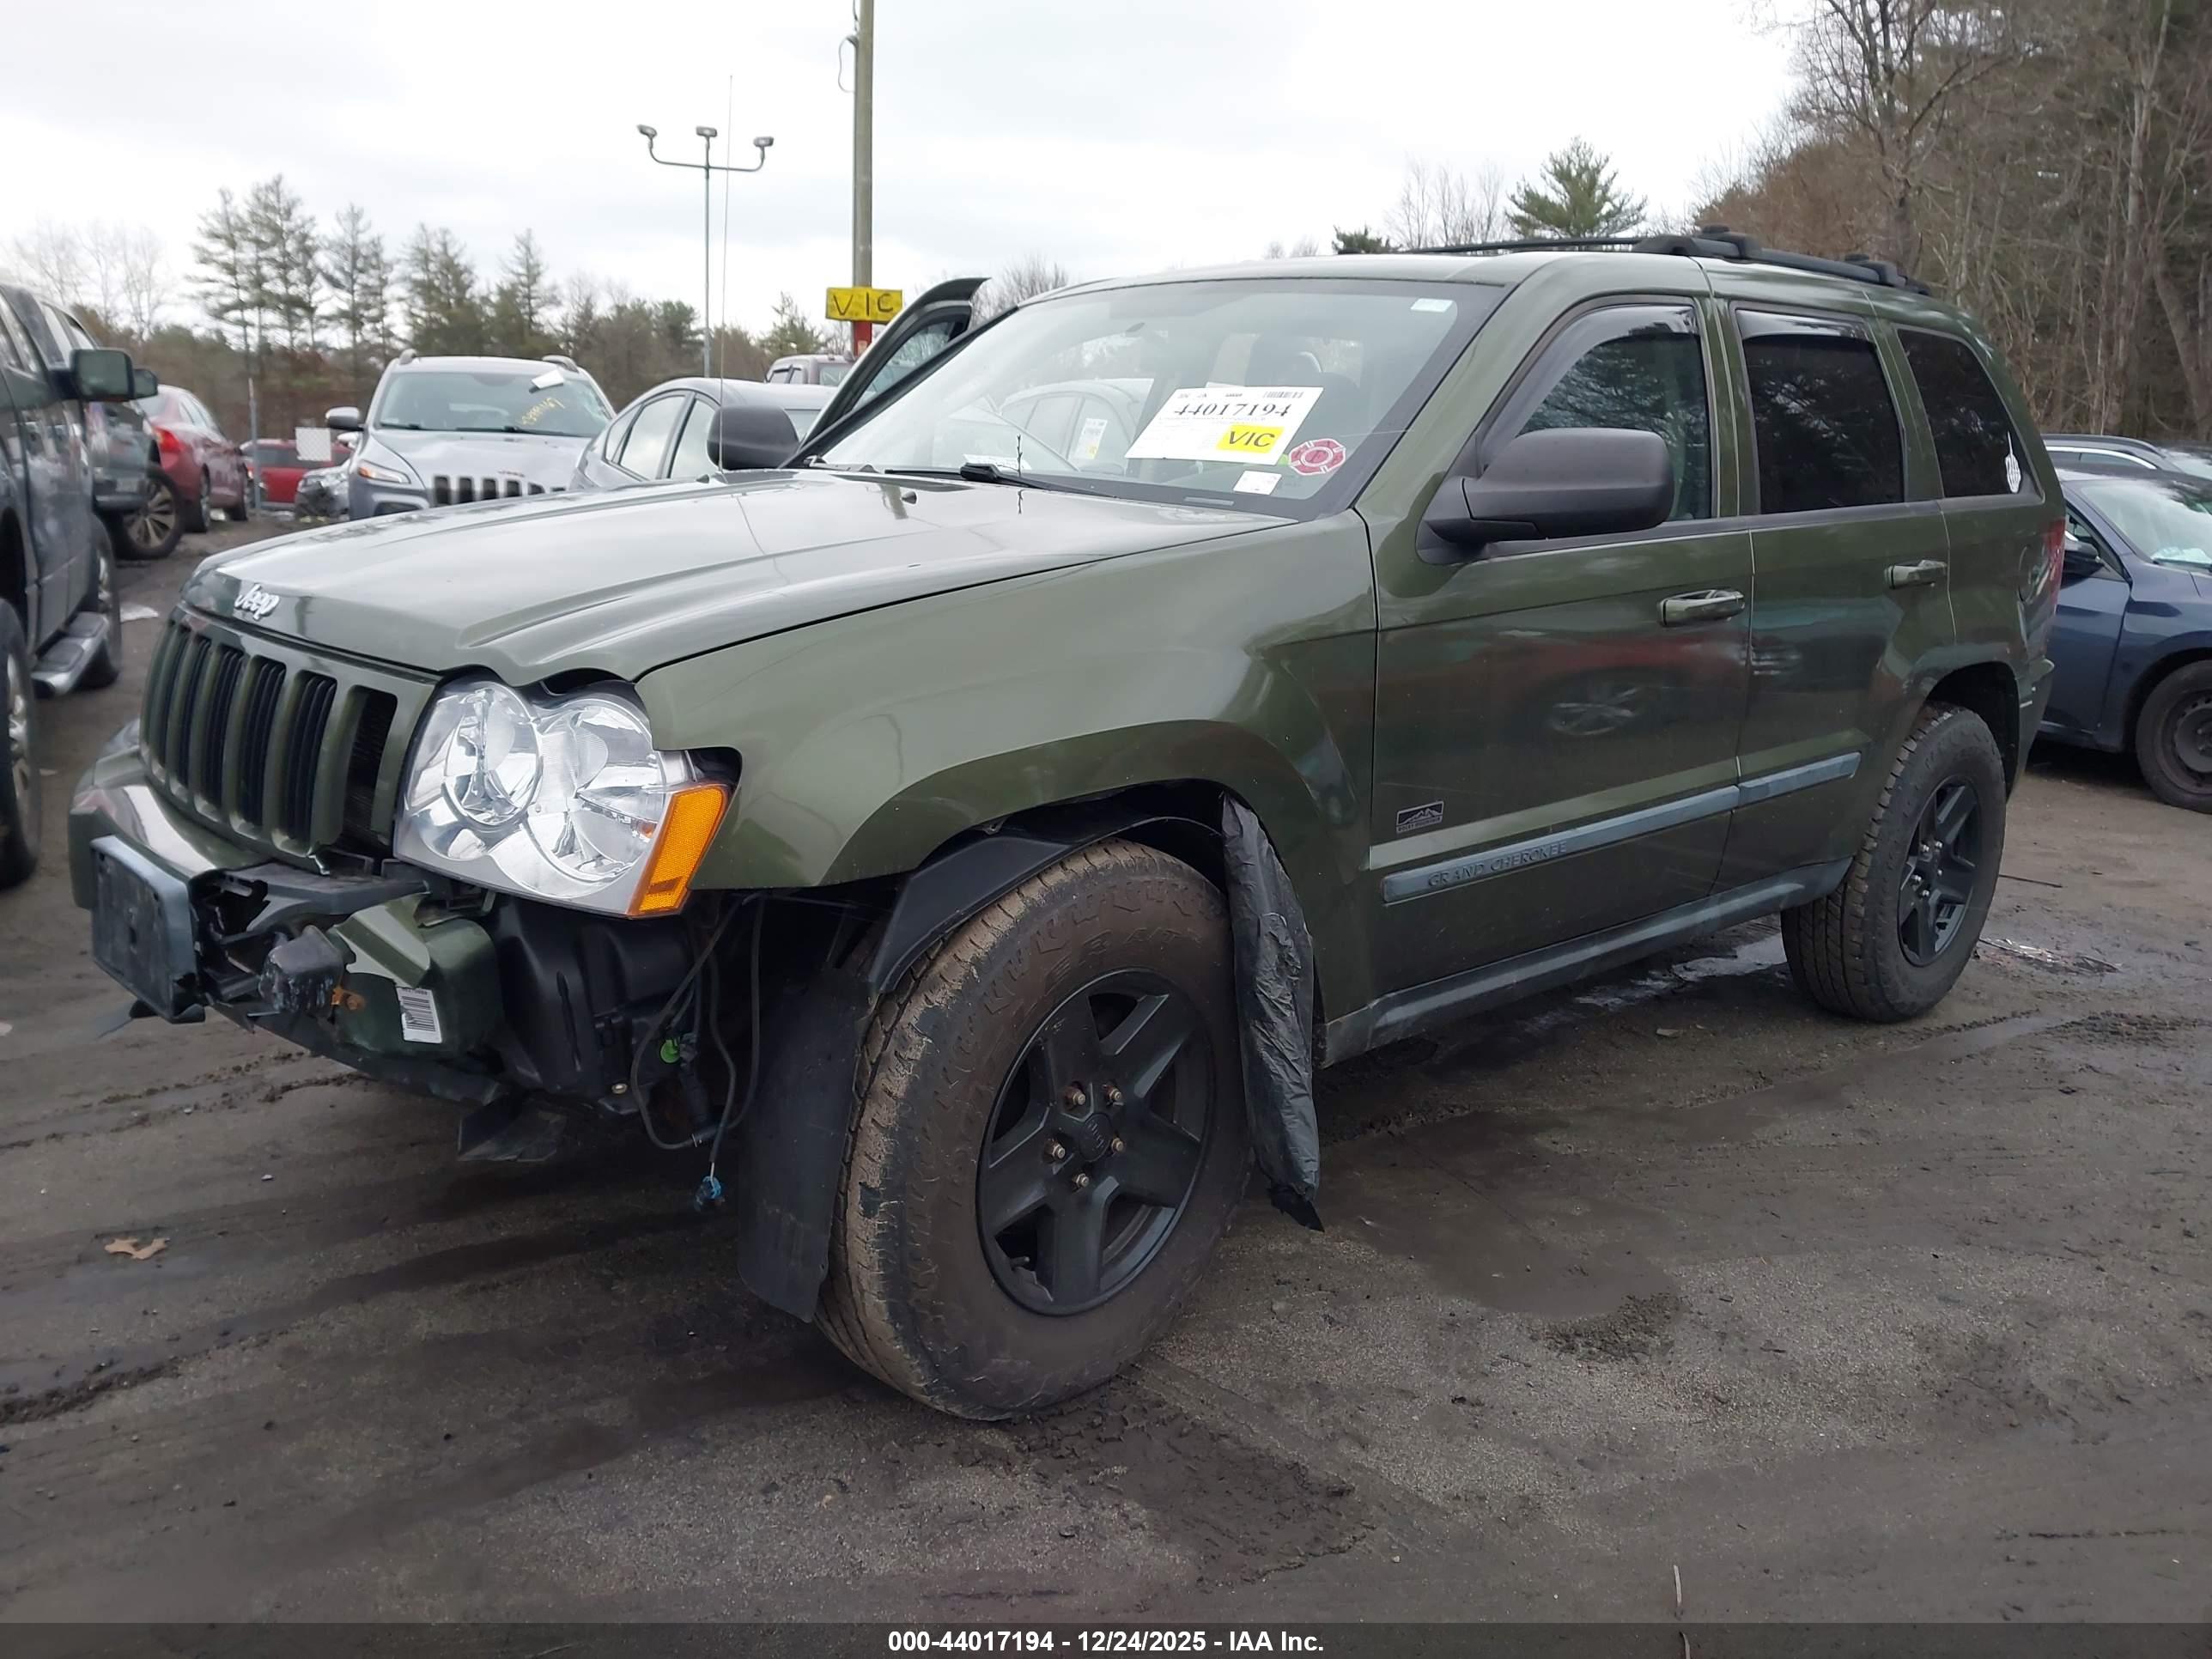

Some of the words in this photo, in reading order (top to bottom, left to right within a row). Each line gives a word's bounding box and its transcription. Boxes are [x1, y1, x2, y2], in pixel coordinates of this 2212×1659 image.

[833, 291, 894, 317] VIC
[1174, 403, 1292, 416] 44017194
[1229, 430, 1276, 447] VIC
[234, 584, 280, 620] Jeep
[1428, 863, 1485, 887] GRAND
[1490, 840, 1567, 872] CHEROKEE
